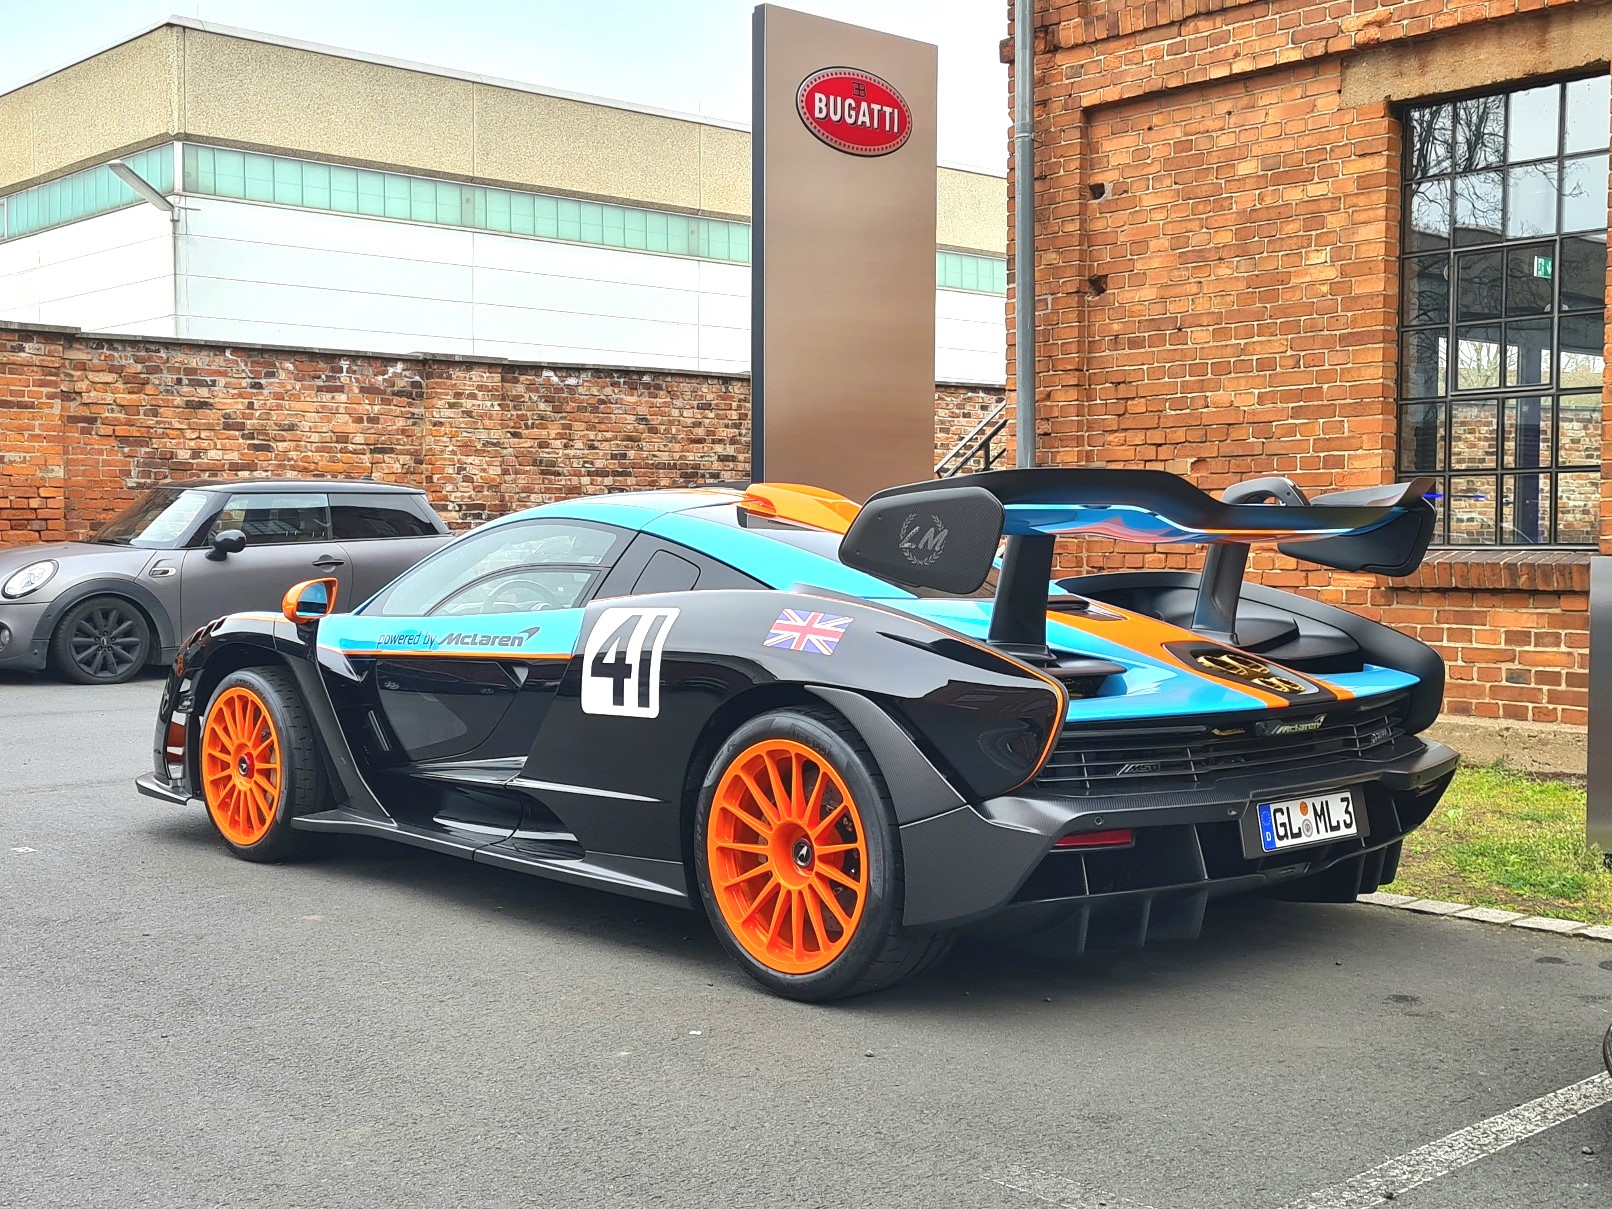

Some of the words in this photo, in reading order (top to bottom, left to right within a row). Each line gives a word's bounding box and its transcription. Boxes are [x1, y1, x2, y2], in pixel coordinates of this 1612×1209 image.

[814, 92, 899, 134] BUGATTI
[899, 526, 949, 551] LM
[377, 631, 422, 649] powered
[424, 631, 437, 650] by
[438, 632, 524, 647] McLaren
[591, 614, 668, 708] 41
[1273, 806, 1302, 842] GL
[1311, 800, 1341, 835] ML
[1340, 797, 1354, 829] 3
